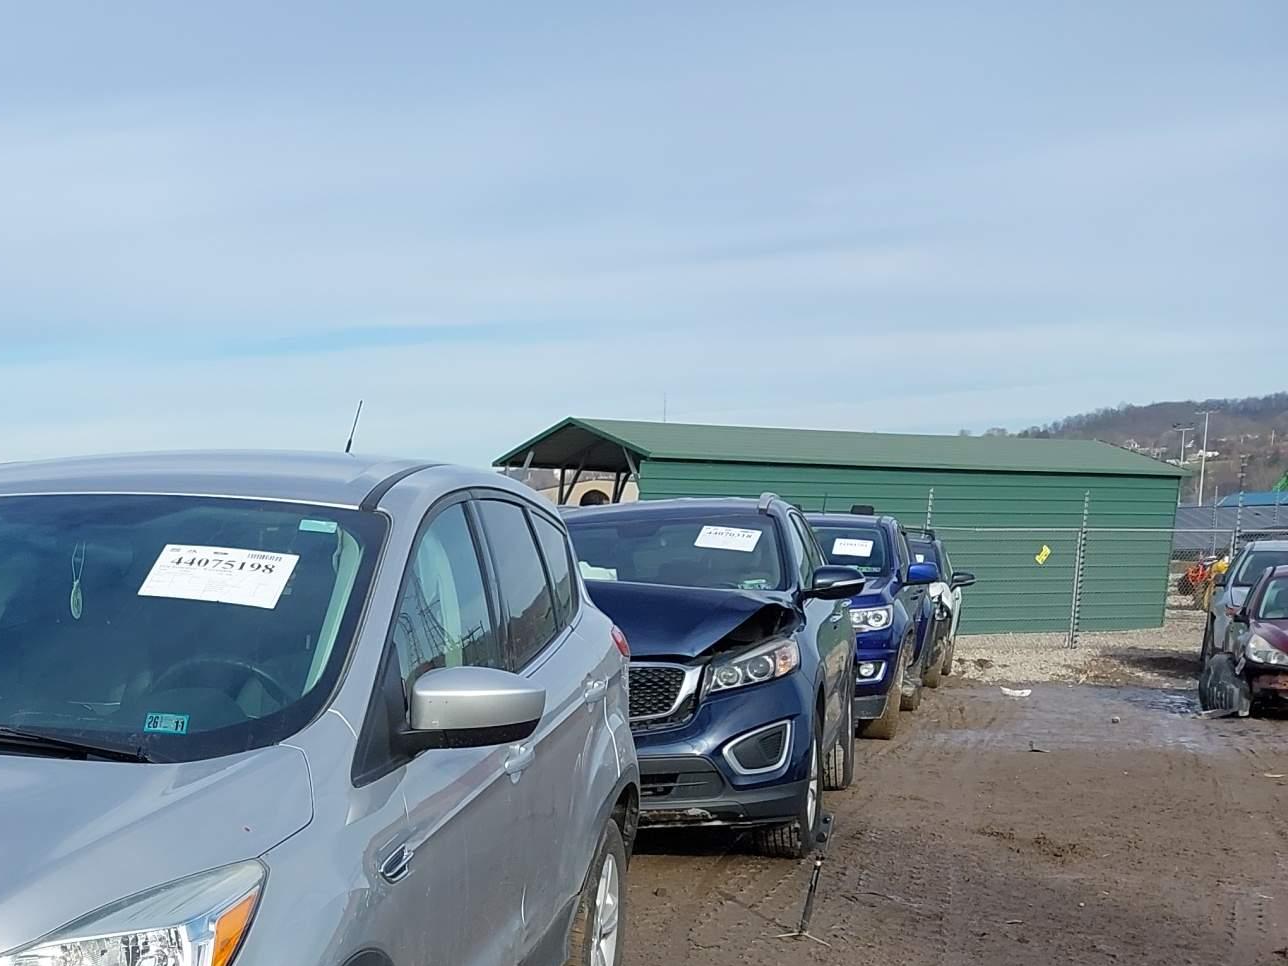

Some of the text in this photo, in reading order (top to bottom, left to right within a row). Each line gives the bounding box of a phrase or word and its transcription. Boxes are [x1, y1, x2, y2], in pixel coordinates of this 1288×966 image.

[170, 555, 276, 574] 44075198
[147, 715, 185, 731] 26 11
